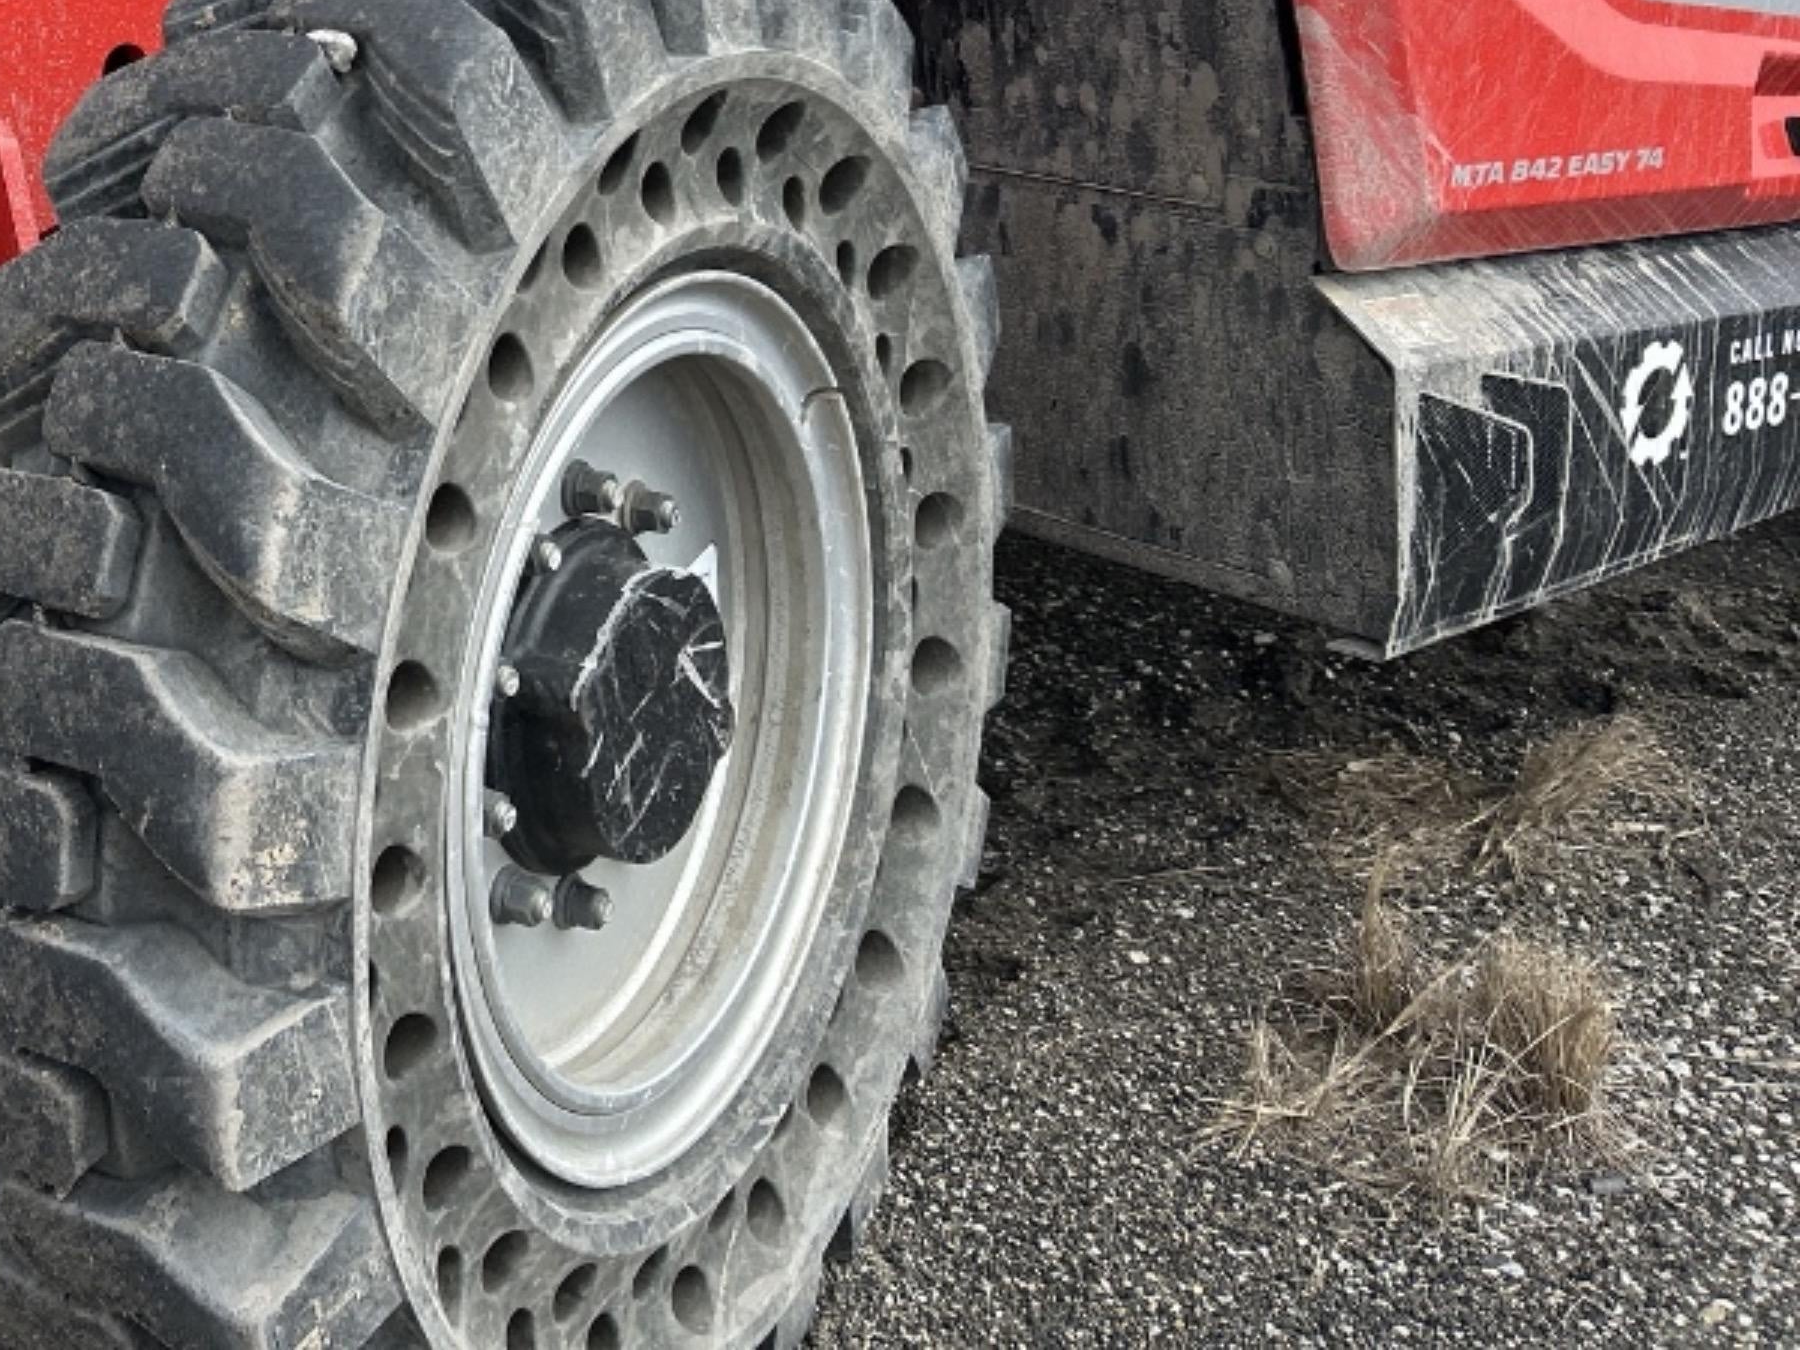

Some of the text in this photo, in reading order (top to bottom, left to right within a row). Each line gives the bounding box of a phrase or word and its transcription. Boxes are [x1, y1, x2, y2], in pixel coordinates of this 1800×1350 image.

[1451, 161, 1505, 187] MTA
[1567, 149, 1630, 178] EASY
[1729, 333, 1775, 365] CALL
